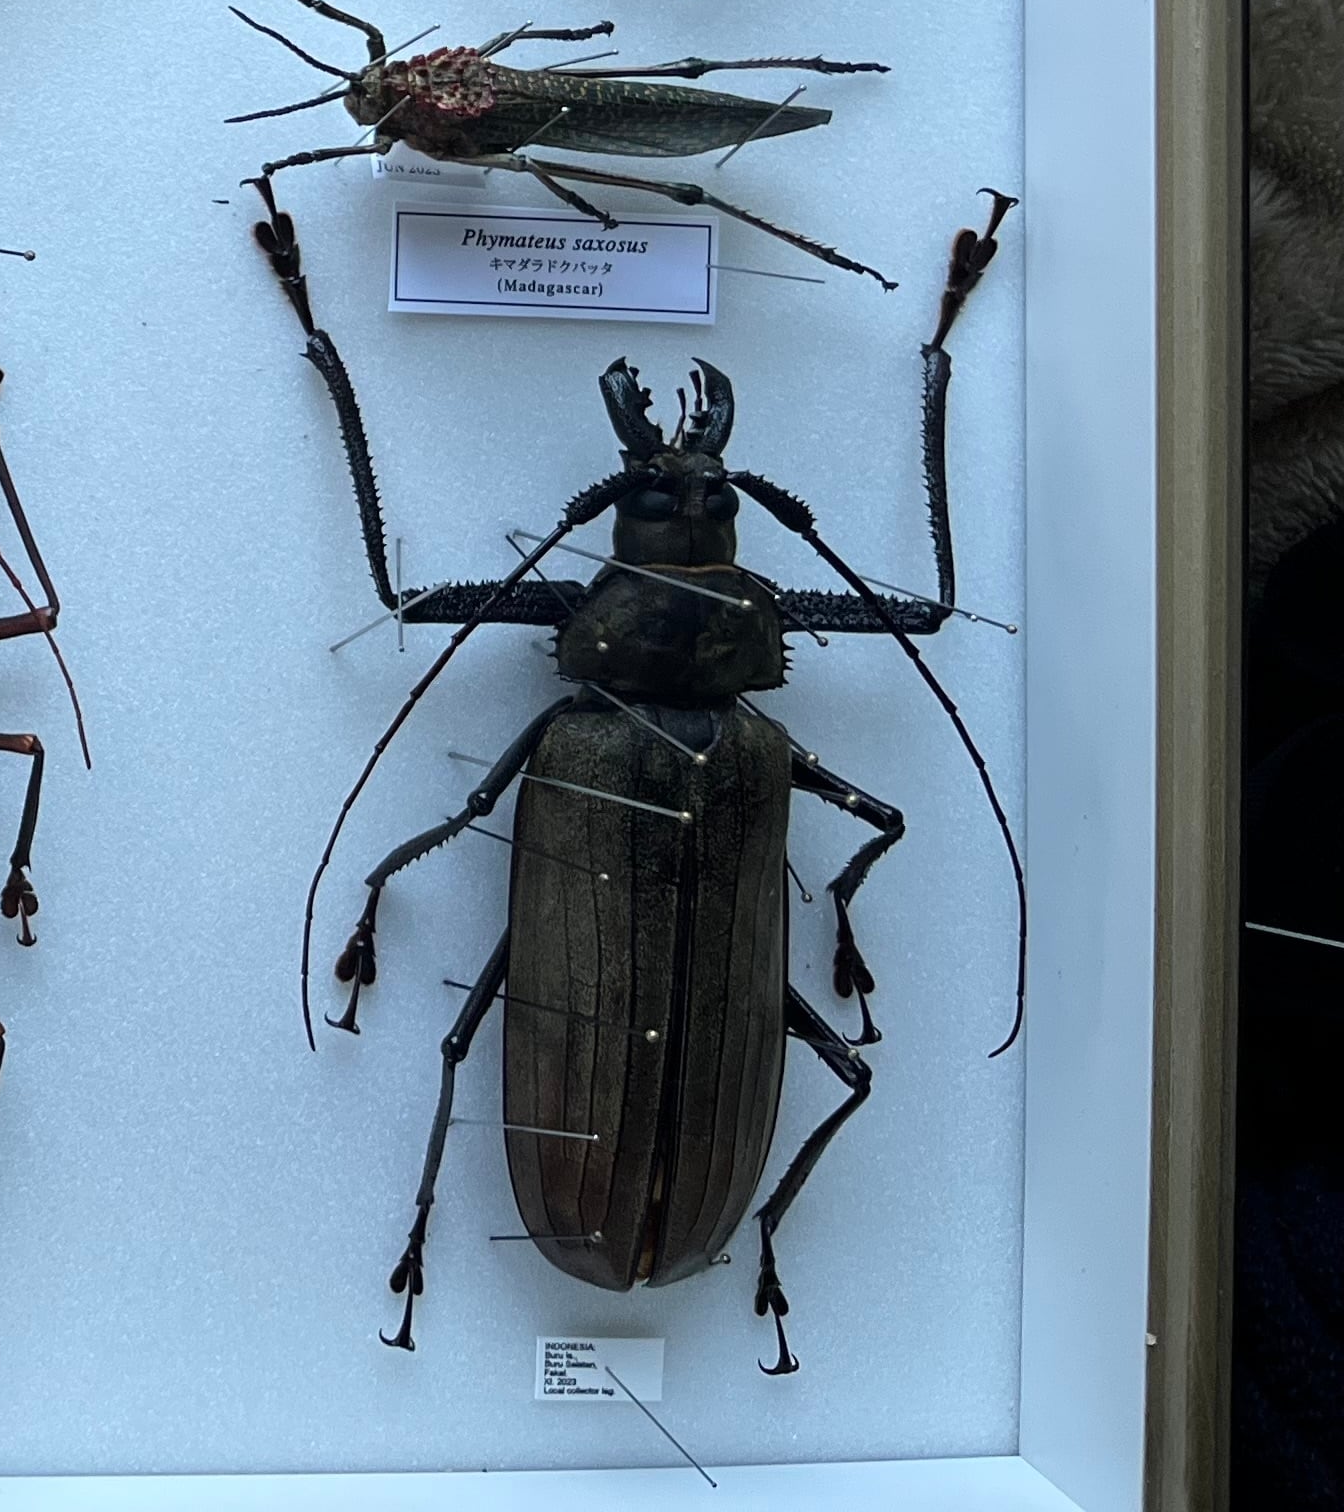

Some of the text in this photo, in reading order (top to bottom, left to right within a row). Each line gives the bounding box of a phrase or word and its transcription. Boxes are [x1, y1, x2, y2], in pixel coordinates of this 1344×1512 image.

[461, 228, 649, 254] Phymateus saxosus
[490, 257, 613, 275] キマダラドクバッタ
[497, 277, 603, 297] (Madagascar)
[544, 1386, 565, 1395] Local
[566, 1386, 600, 1395] collector
